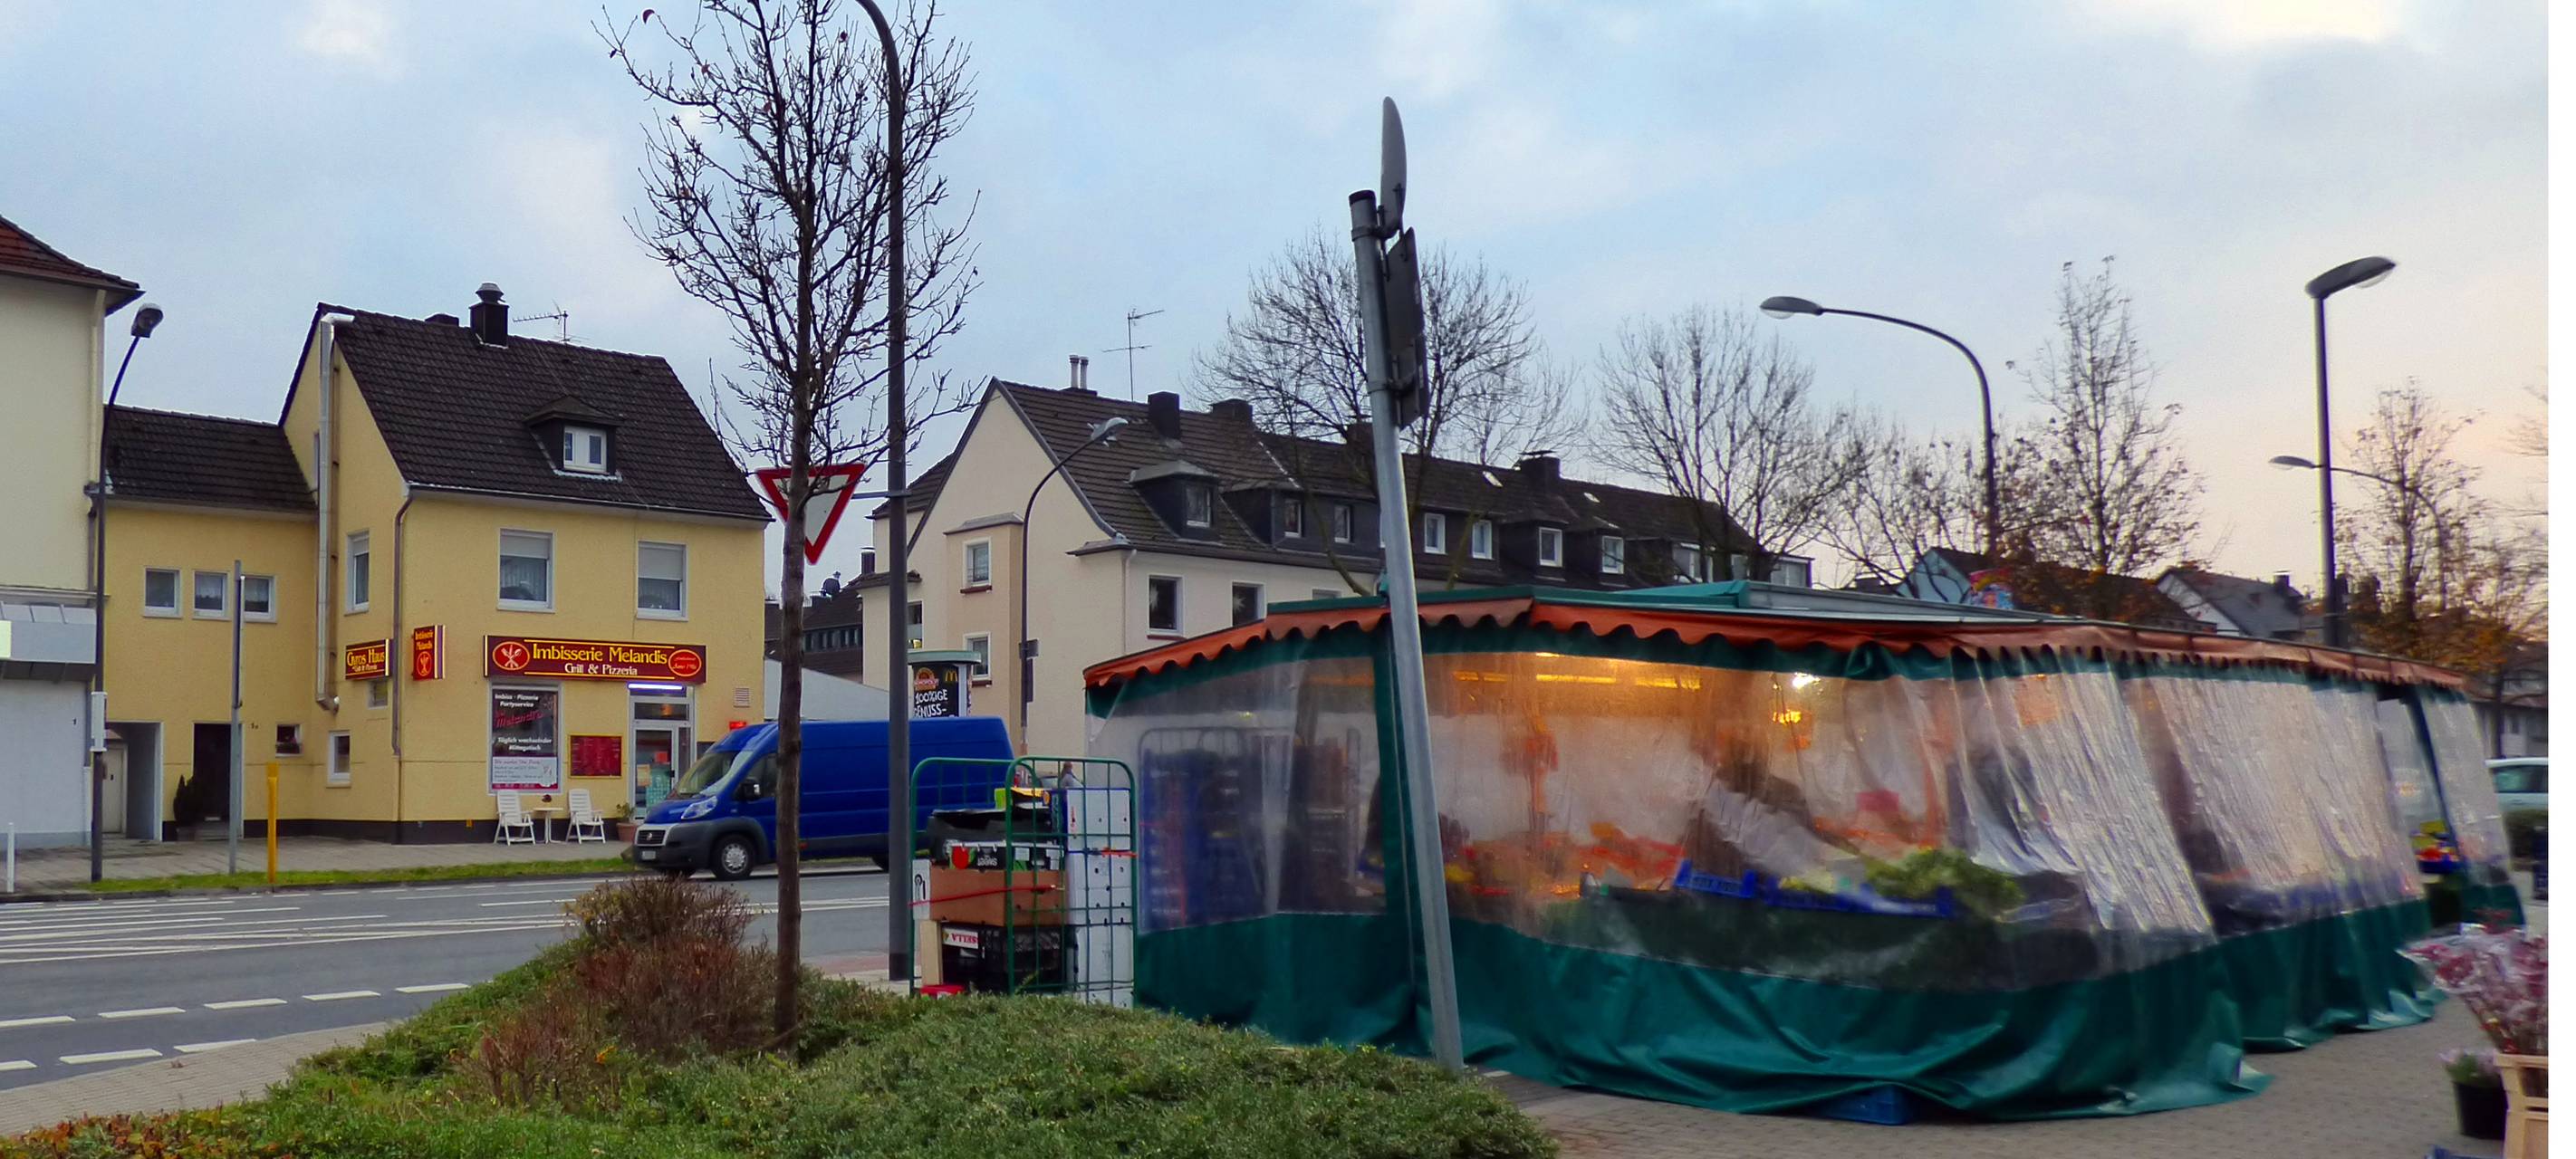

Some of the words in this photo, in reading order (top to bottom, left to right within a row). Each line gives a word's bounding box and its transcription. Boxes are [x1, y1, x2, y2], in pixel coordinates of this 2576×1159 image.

[347, 651, 367, 666] Gyros
[368, 648, 385, 664] Haus
[533, 643, 603, 661] Imbisserie
[609, 647, 668, 665] Melandis
[564, 663, 584, 674] Grill
[588, 664, 598, 674] &
[602, 664, 638, 675] Pizzeria
